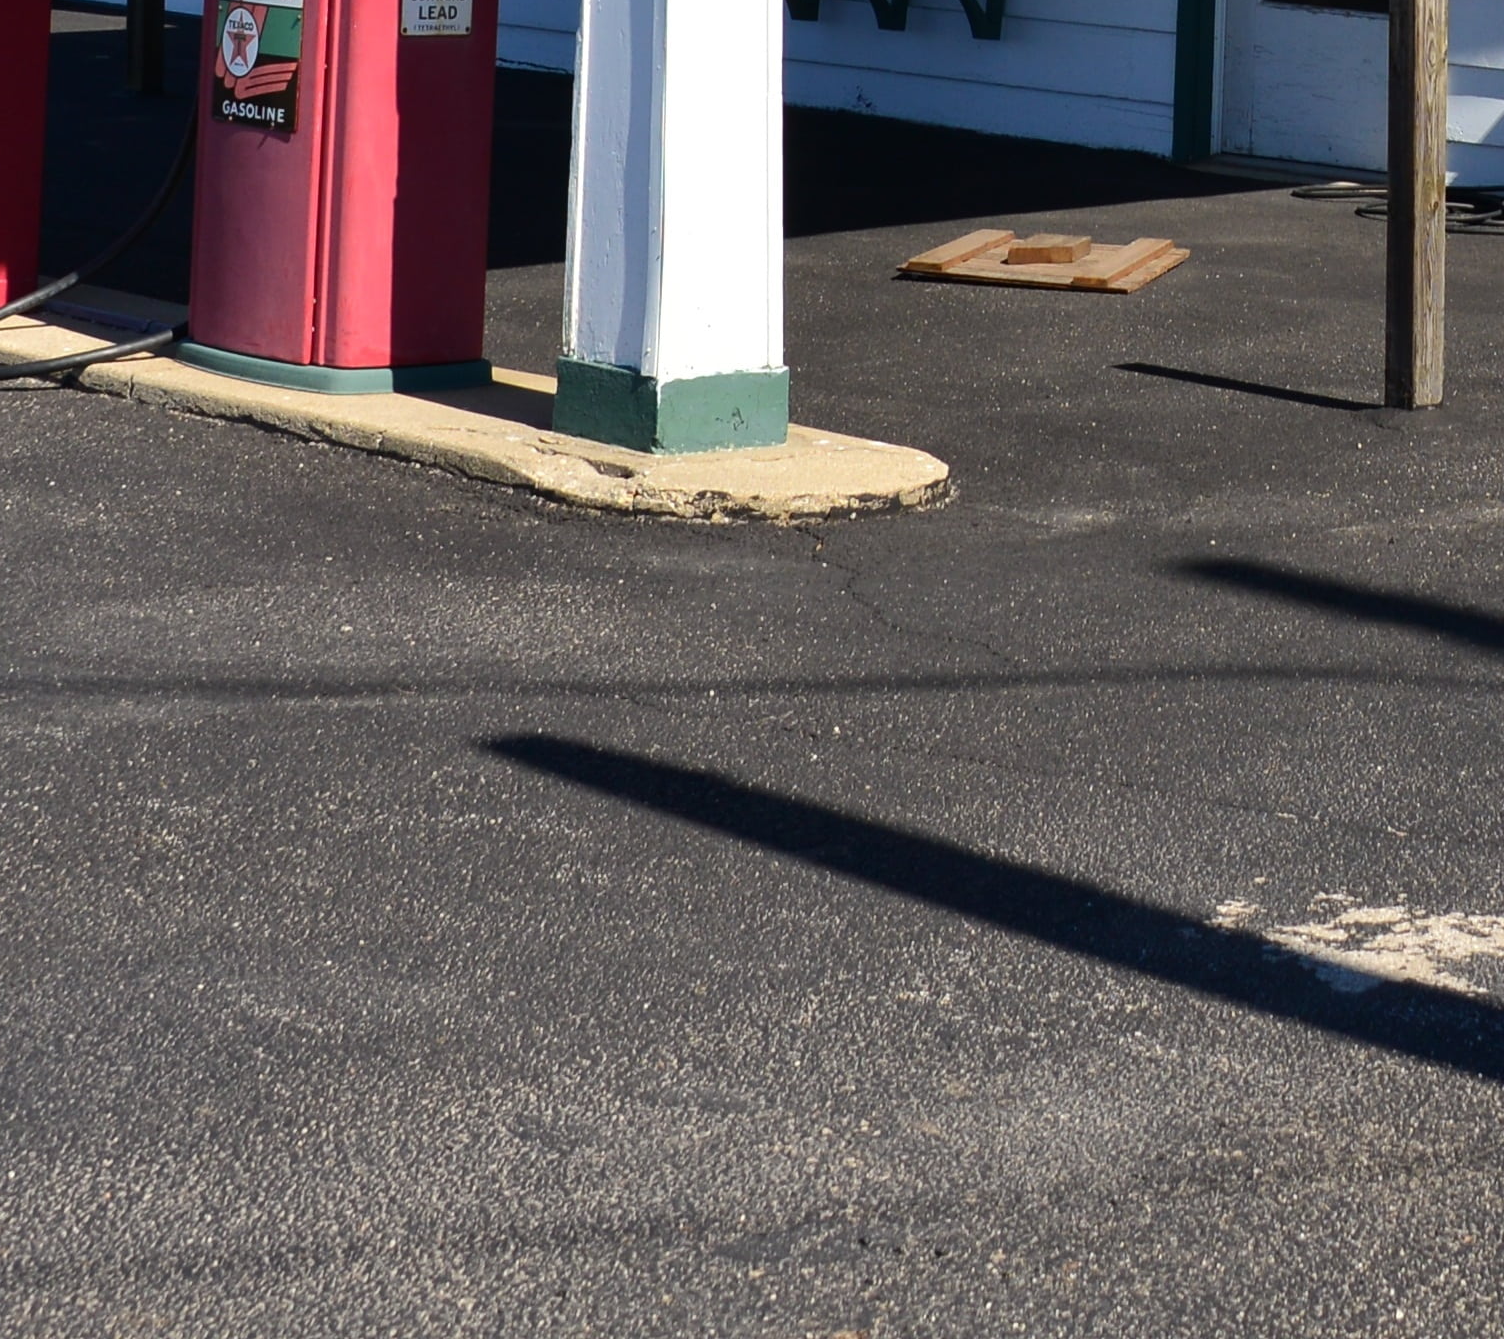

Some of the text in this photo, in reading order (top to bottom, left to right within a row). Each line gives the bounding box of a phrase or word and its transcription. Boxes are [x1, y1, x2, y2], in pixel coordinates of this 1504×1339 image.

[419, 5, 458, 20] LEAD
[228, 20, 254, 31] TEXACO
[222, 99, 286, 124] GASOLINE
